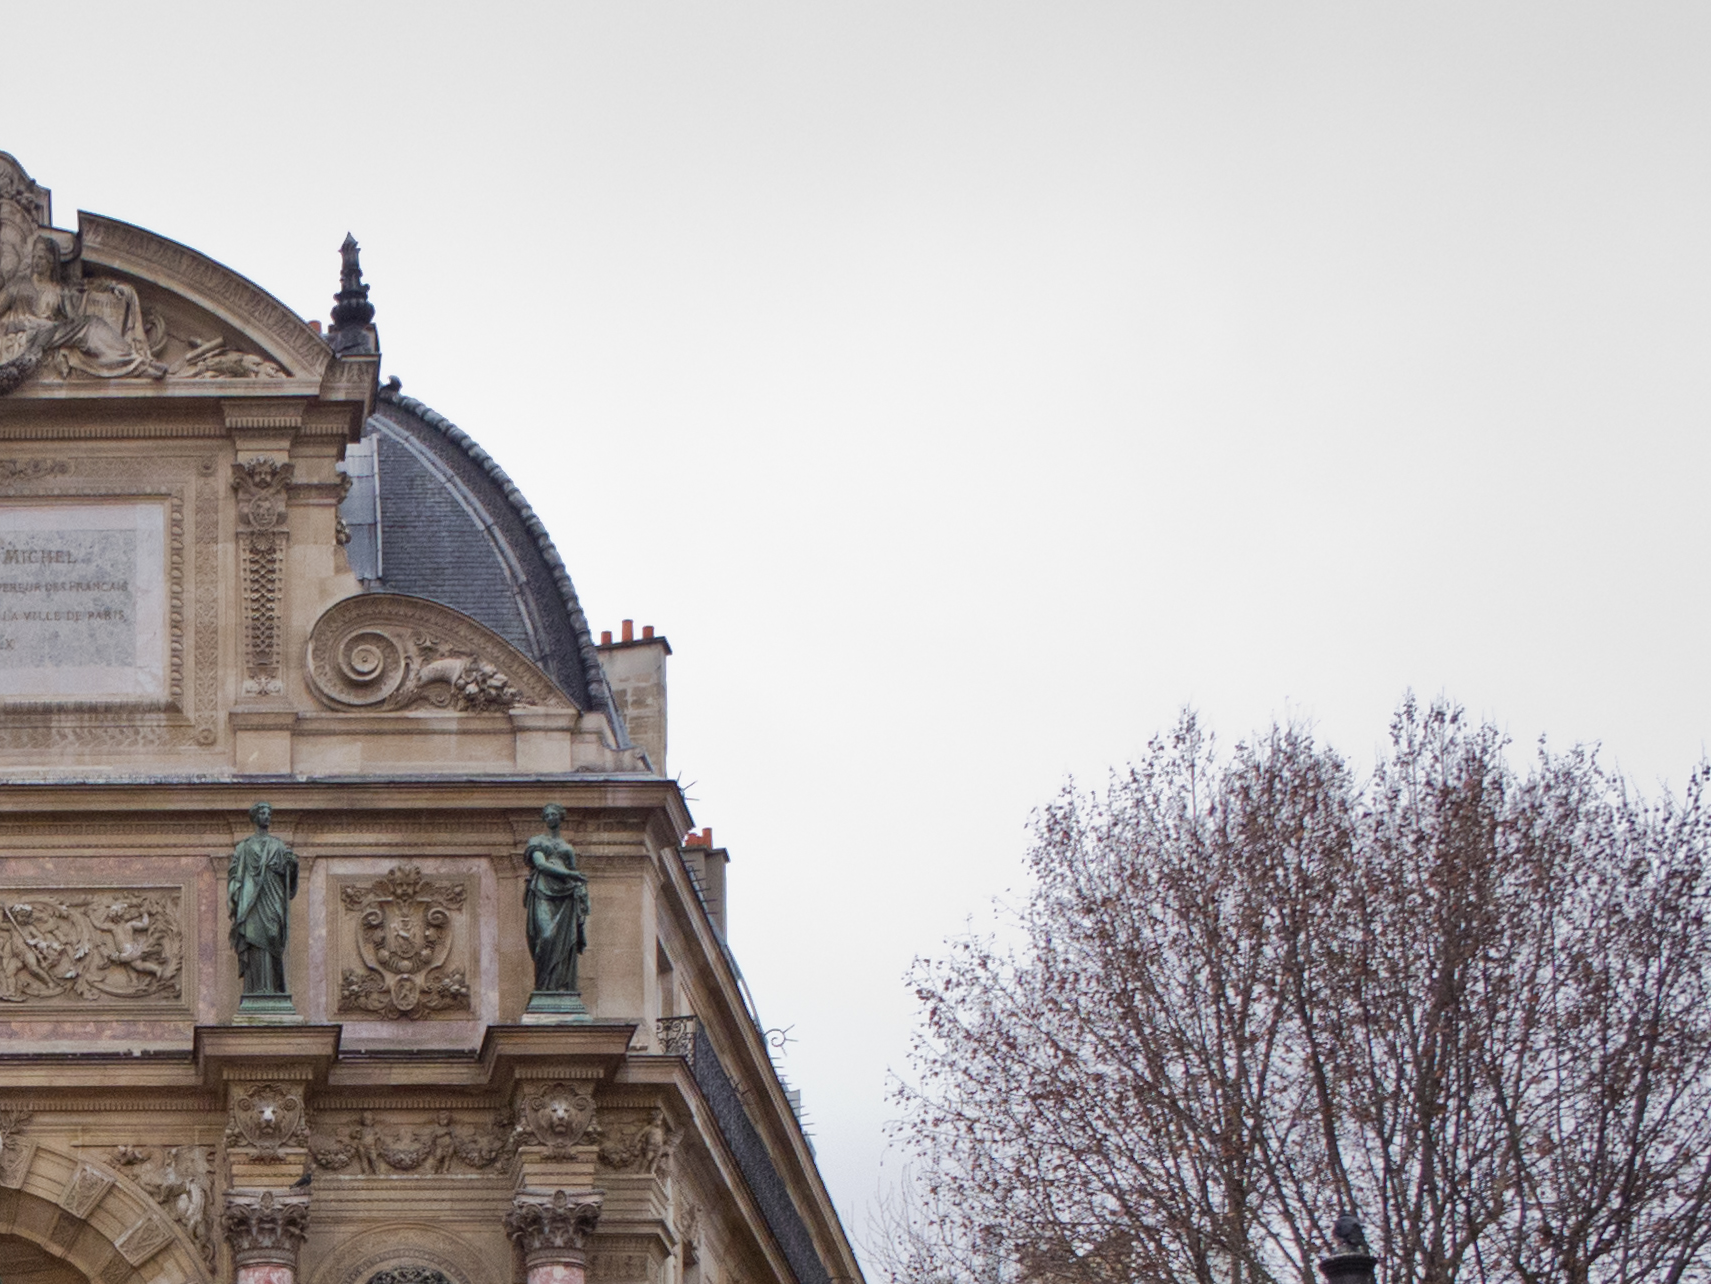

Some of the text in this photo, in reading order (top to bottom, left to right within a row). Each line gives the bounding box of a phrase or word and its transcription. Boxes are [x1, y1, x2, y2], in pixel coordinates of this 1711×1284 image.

[1, 549, 78, 565] MICHEL
[2, 611, 19, 622] LA
[22, 610, 61, 622] VILLE
[65, 610, 81, 622] DE
